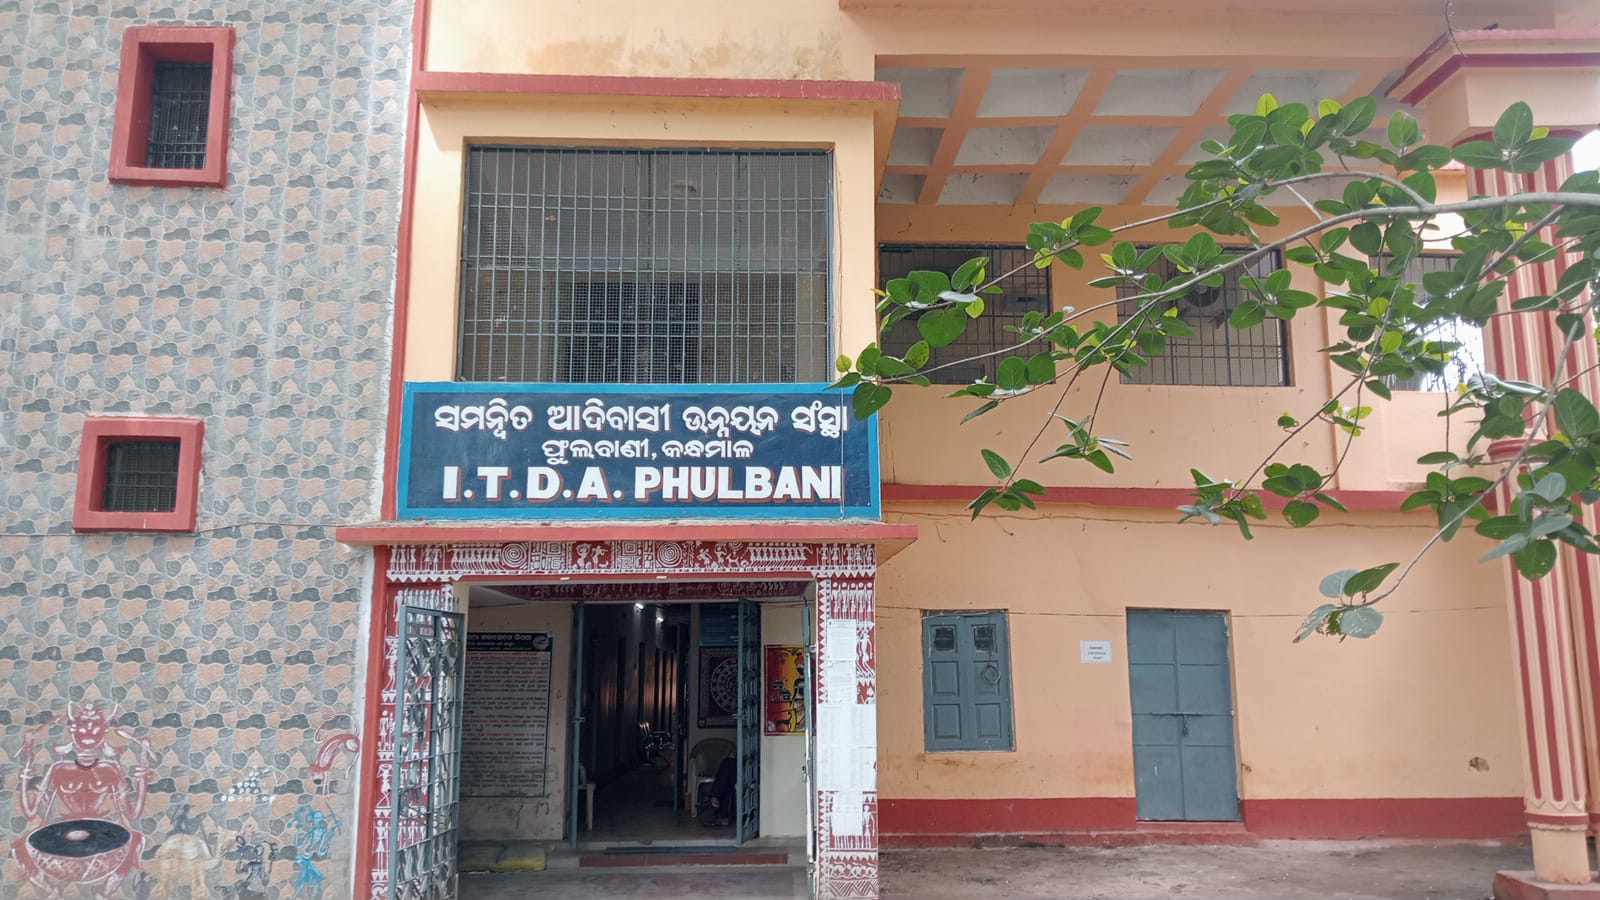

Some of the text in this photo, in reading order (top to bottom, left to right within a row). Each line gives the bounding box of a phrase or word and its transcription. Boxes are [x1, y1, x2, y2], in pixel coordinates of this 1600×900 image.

[547, 397, 672, 432] ଆଦିବାସୀ
[682, 405, 780, 438] ଉନ୍ନୟନ
[790, 400, 849, 439] ସଂସ୍ଥା
[541, 437, 754, 466] ଫୁଲବାଣୀ, କନ୍ଧମାଳ
[635, 465, 844, 502] PHULBANI
